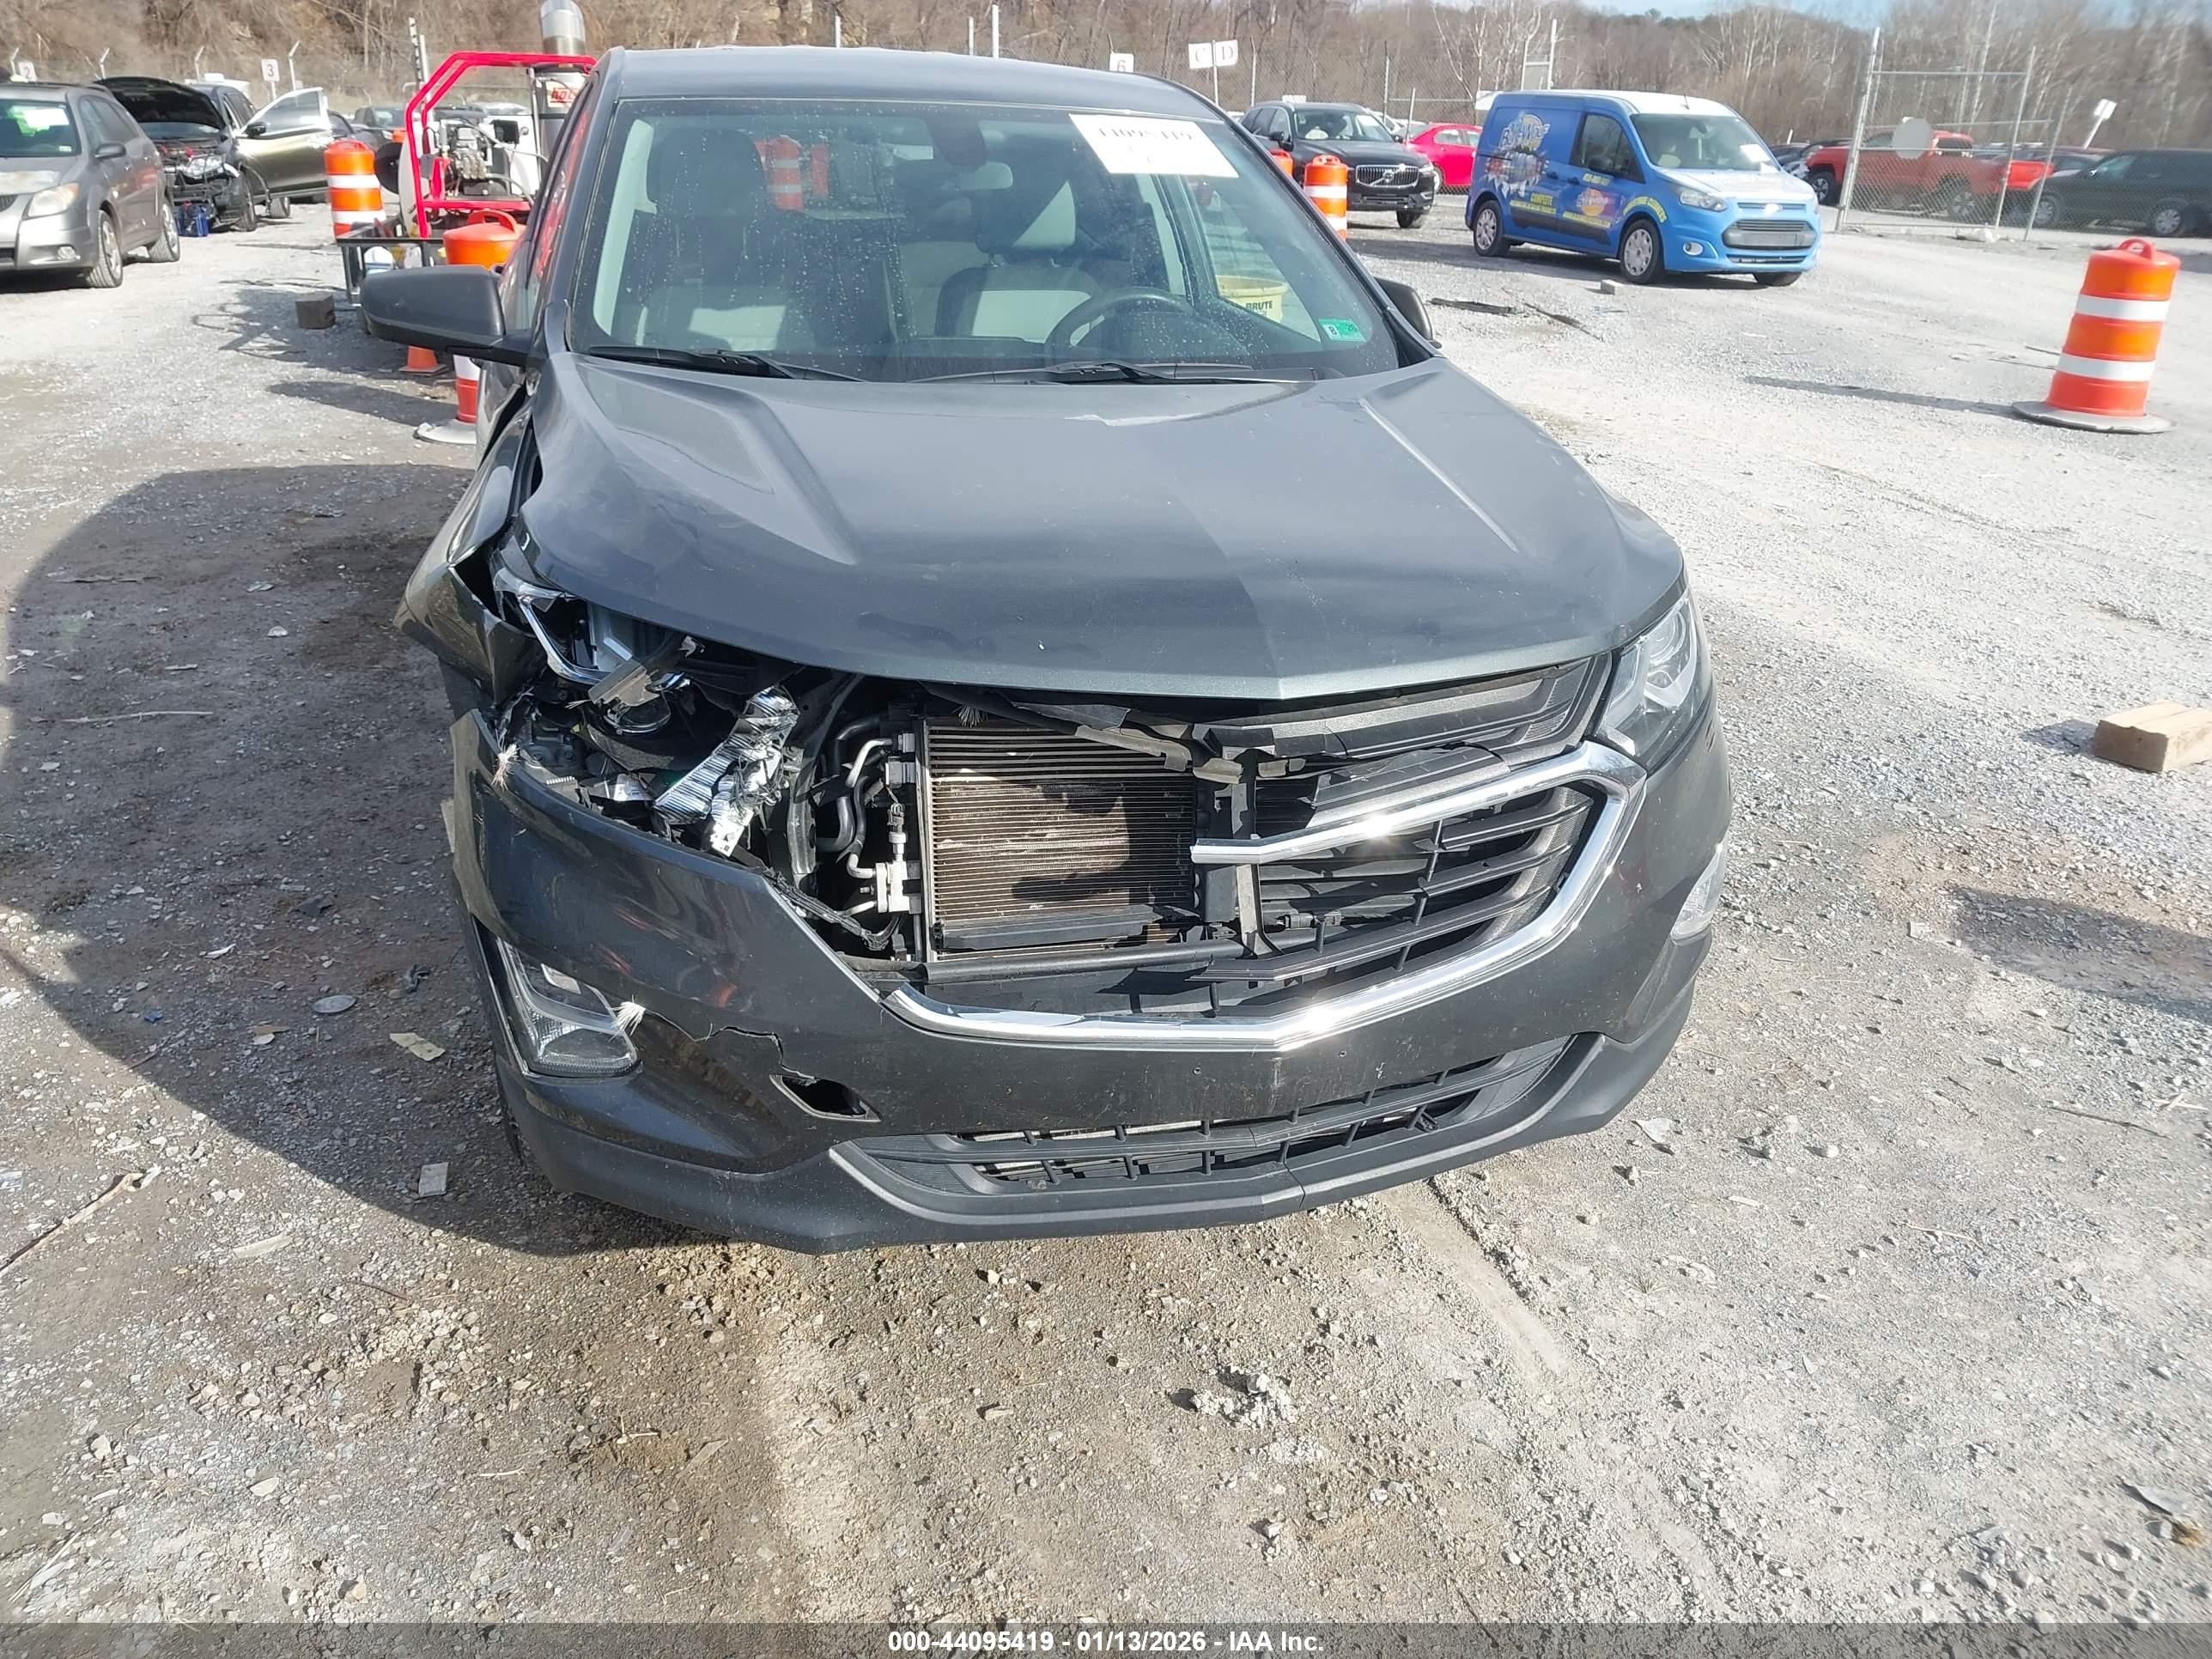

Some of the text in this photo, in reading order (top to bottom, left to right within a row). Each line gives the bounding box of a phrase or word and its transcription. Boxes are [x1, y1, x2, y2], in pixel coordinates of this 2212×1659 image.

[1221, 46, 1235, 61] D
[266, 64, 275, 76] 3
[1116, 58, 1127, 72] 6
[1245, 300, 1273, 311] BRUTE
